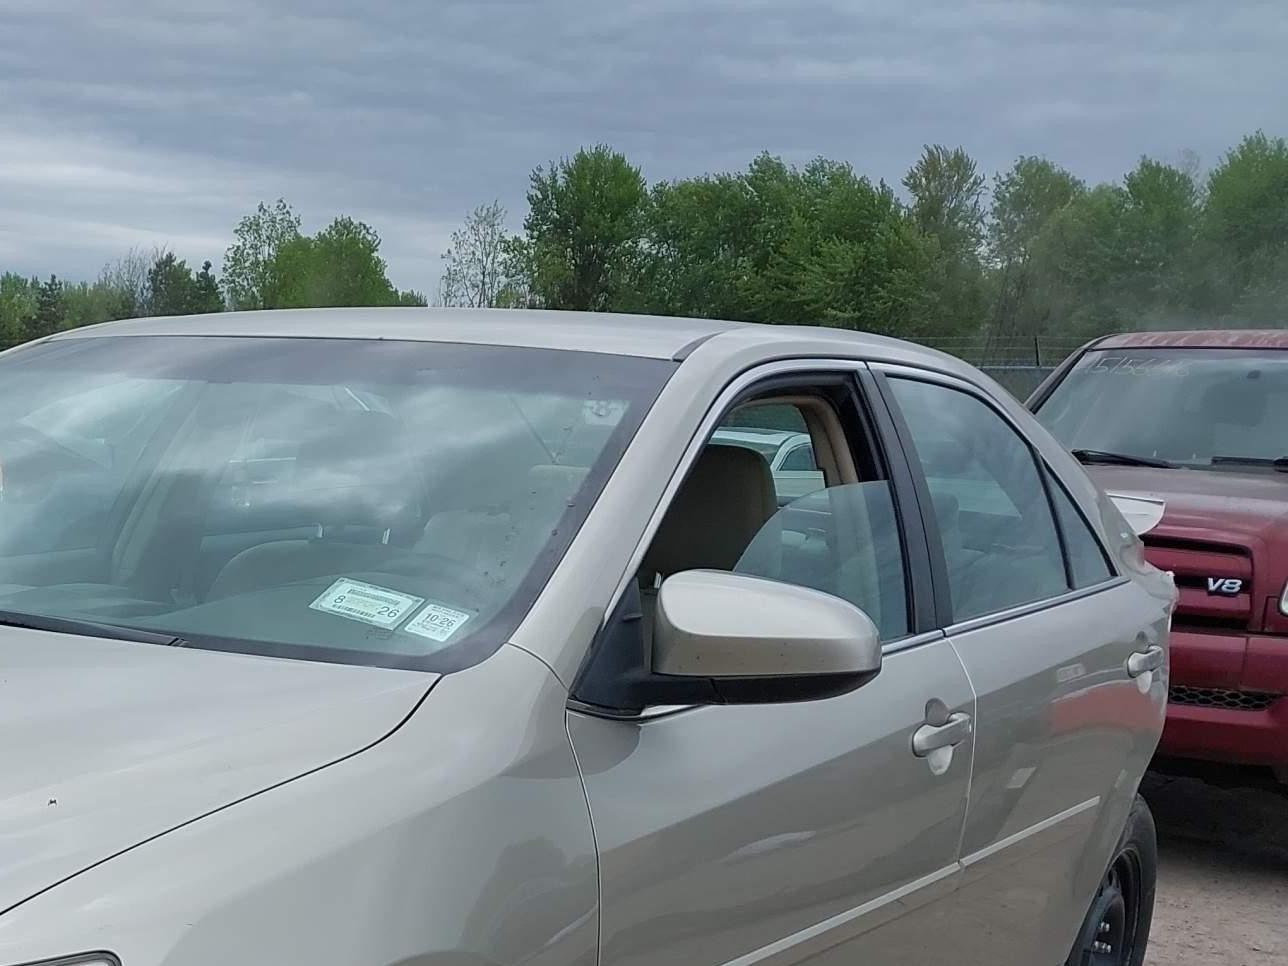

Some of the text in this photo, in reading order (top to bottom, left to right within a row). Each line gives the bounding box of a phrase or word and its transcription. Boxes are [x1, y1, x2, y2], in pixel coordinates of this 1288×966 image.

[1208, 577, 1242, 592] V8
[334, 595, 346, 604] 8
[377, 606, 400, 618] 26
